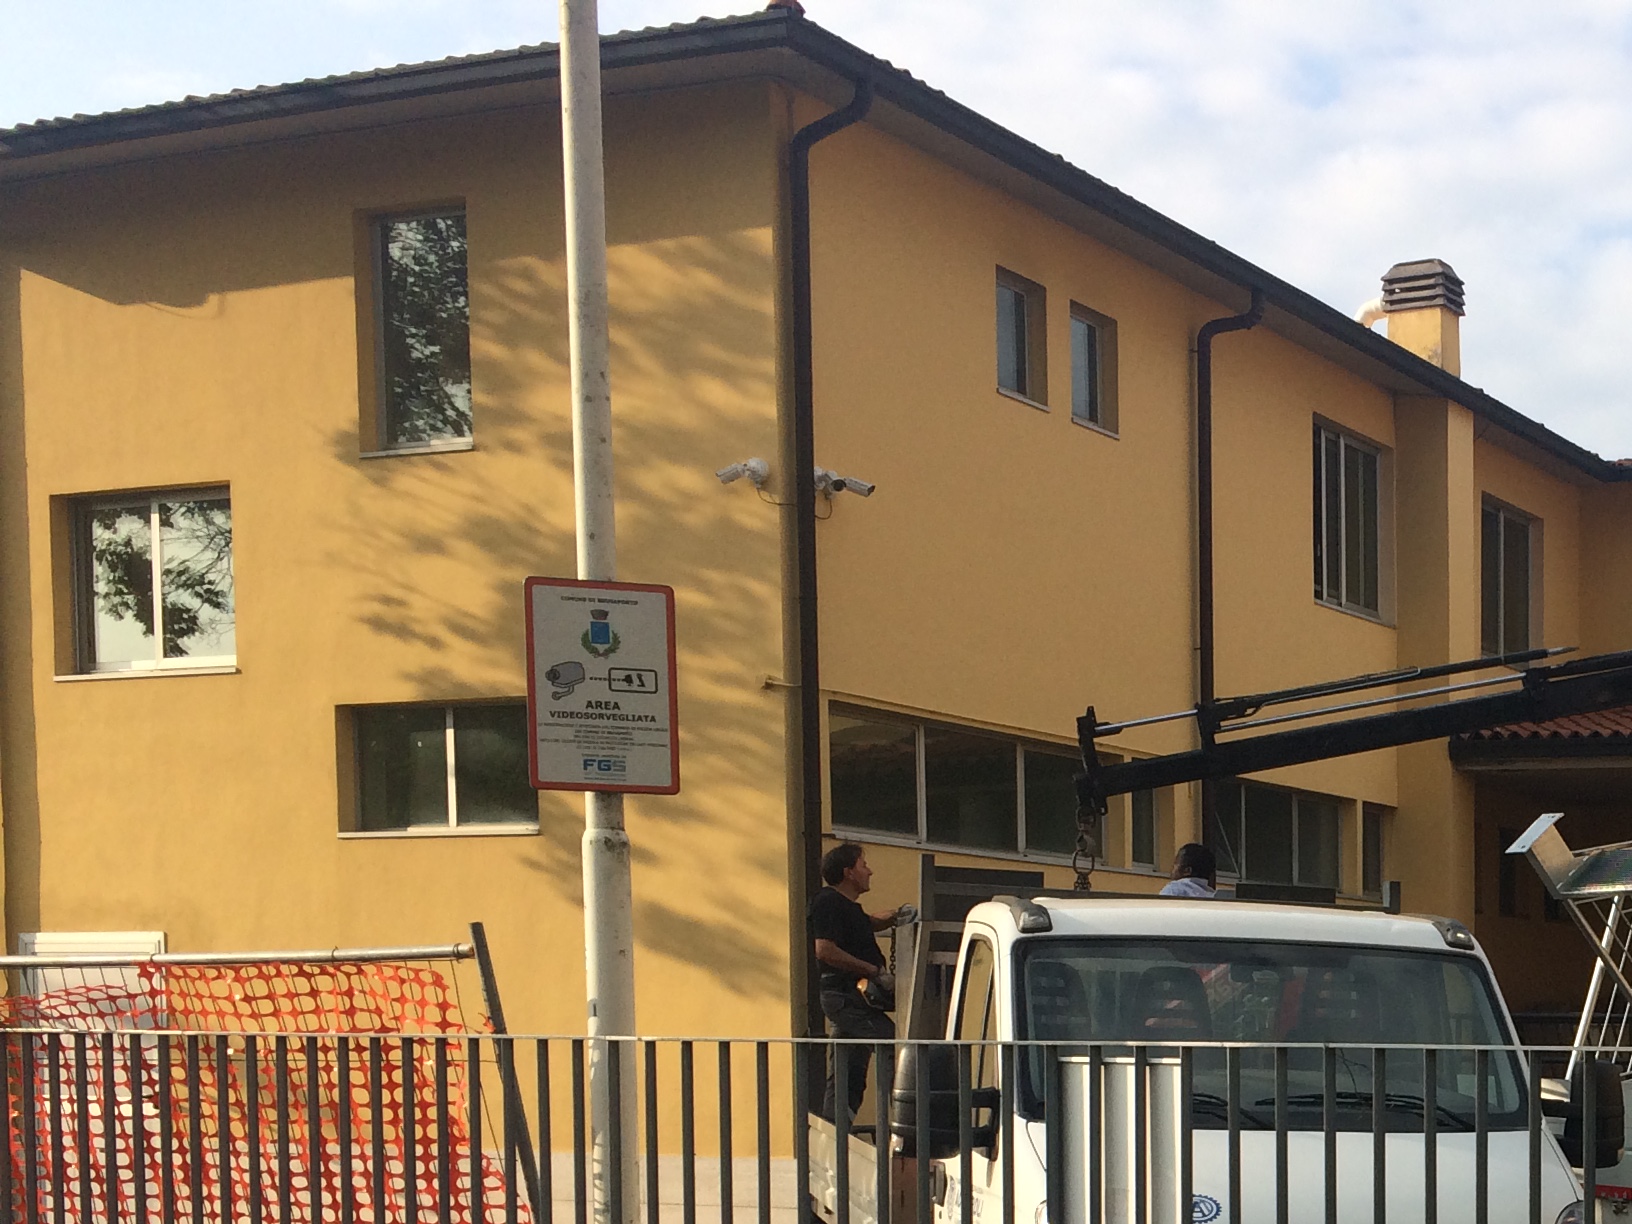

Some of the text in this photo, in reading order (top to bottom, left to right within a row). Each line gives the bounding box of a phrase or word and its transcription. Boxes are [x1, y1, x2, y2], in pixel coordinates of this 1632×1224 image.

[585, 700, 621, 711] AREA
[549, 710, 657, 723] VIDEOSORVEGLIATA
[583, 759, 627, 772] FGS
